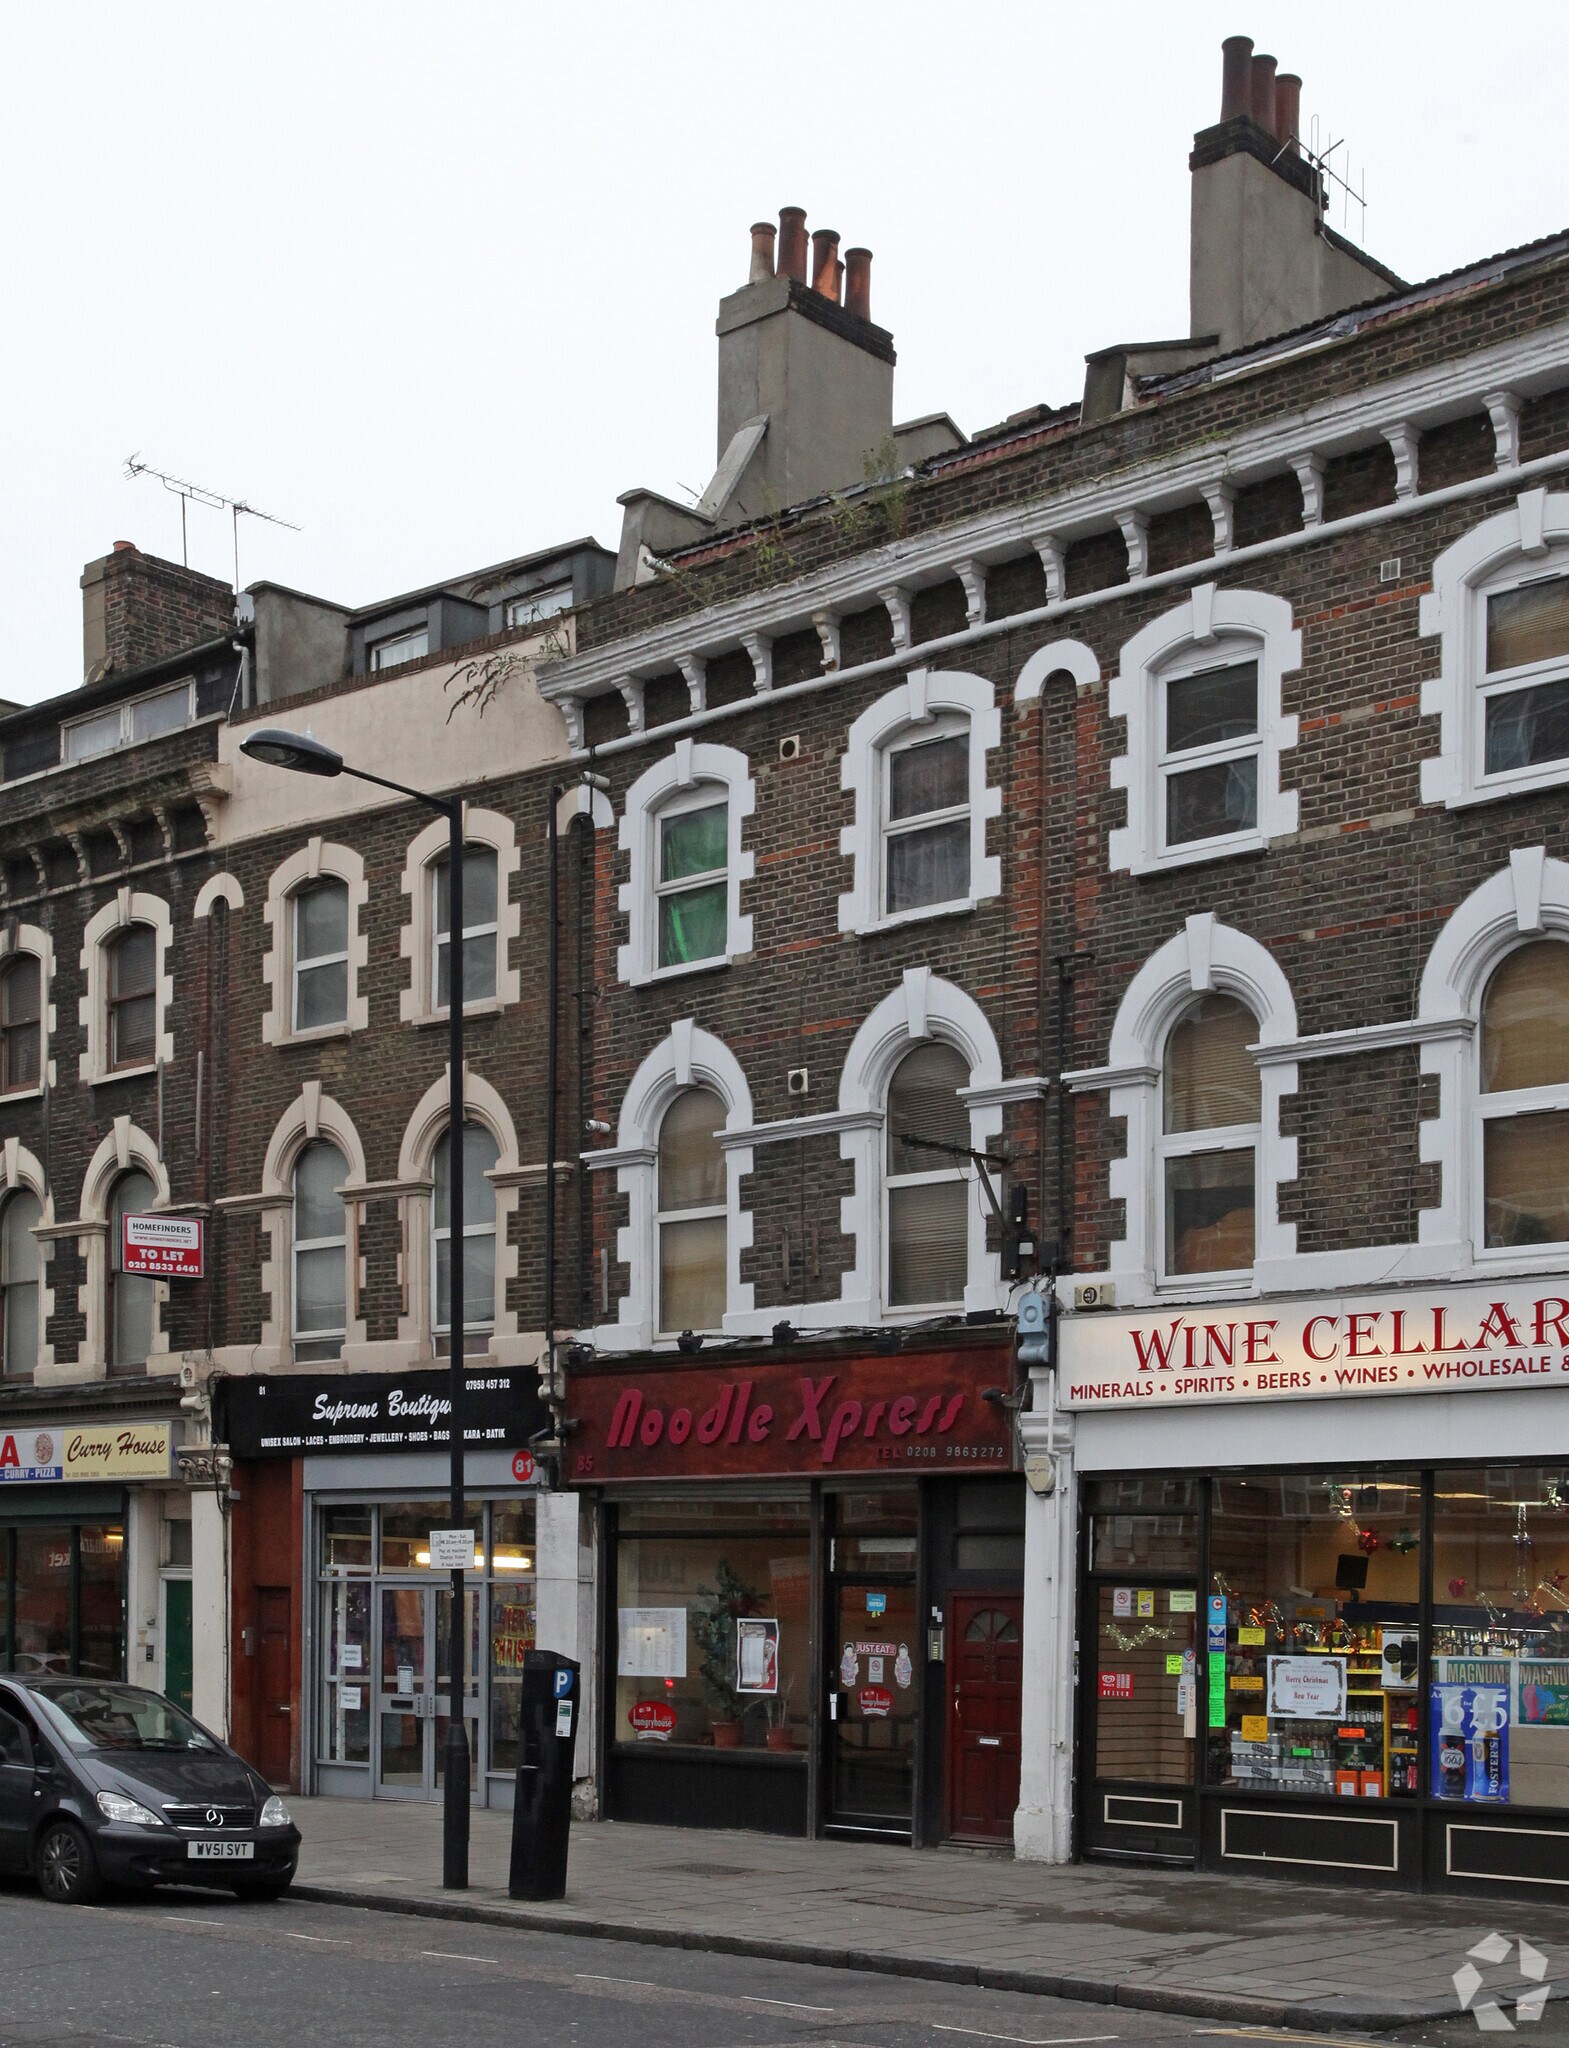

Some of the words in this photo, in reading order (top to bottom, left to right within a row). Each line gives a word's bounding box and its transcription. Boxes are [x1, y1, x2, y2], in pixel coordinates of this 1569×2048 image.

[132, 1222, 191, 1234] HOMEFINDERS
[139, 1248, 158, 1260] TO
[162, 1250, 185, 1262] LET
[128, 1261, 147, 1270] 020
[149, 1262, 174, 1272] 8533
[176, 1265, 199, 1273] 6461
[1127, 1316, 1285, 1375] WINE
[465, 1380, 485, 1390] 07958
[486, 1380, 498, 1389] 457
[499, 1378, 510, 1389] 312
[1070, 1380, 1154, 1400] MINERALS
[1174, 1376, 1235, 1394] SPIRITS
[1256, 1371, 1311, 1390] BEERS
[1334, 1366, 1398, 1384] WINES
[1422, 1356, 1551, 1379] WHOLESALE
[258, 1386, 266, 1395] 81
[312, 1393, 379, 1427] Supreme
[388, 1389, 452, 1425] Boutiqu
[606, 1381, 774, 1448] Noodle
[785, 1375, 965, 1463] Xpress
[260, 1437, 281, 1447] UNISEX
[282, 1436, 301, 1447] SALON
[305, 1435, 324, 1446] LACES
[328, 1433, 364, 1445] EMBROIDERY
[369, 1432, 403, 1443] JEWELLERY
[408, 1430, 428, 1442] SHOES
[433, 1430, 450, 1441] BAGS
[486, 1427, 506, 1439] BATIK
[67, 1435, 112, 1462] Curry
[117, 1431, 166, 1456] House
[906, 1446, 936, 1457] 0208
[946, 1446, 1004, 1458] 9863272
[4, 1469, 29, 1479] CURRY
[34, 1467, 56, 1478] PIZZA
[514, 1459, 532, 1474] 81
[856, 1645, 875, 1653] JUST
[876, 1646, 890, 1654] EAT
[1285, 1675, 1301, 1684] Merry
[1303, 1675, 1328, 1684] Christmas
[1447, 1664, 1505, 1684] MAGNUM
[1520, 1665, 1569, 1687] MAGNU
[1294, 1692, 1305, 1700] New
[1307, 1692, 1319, 1700] Year
[633, 1708, 672, 1728] hungryhouse
[1445, 1695, 1465, 1724] 6
[1470, 1694, 1507, 1730] £5
[1488, 1741, 1499, 1794] FOSTER'S
[197, 1843, 224, 1856] WV51
[226, 1843, 248, 1856] SVT
